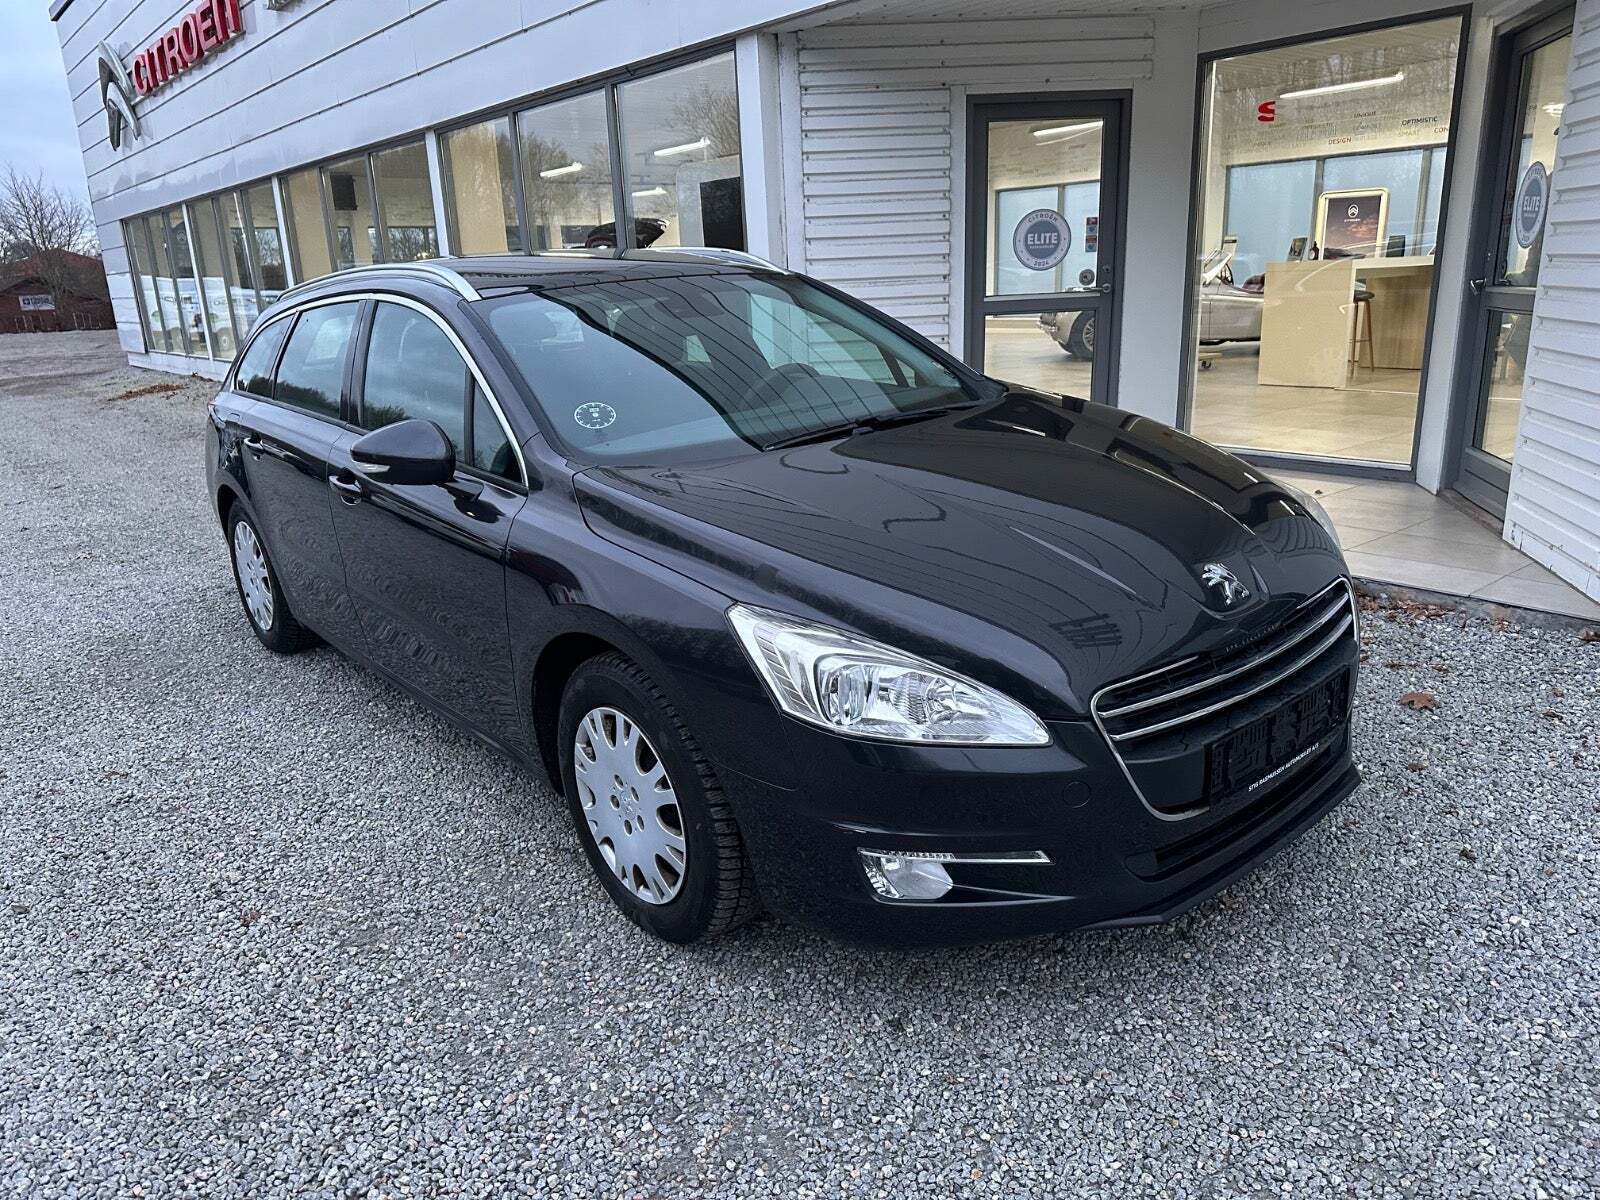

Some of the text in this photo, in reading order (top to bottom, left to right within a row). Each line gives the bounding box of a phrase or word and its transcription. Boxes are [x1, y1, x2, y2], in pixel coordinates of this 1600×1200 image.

[1400, 116, 1437, 126] OPTIMISTIC
[1328, 137, 1352, 145] DESIGN
[1028, 233, 1058, 245] ELITE
